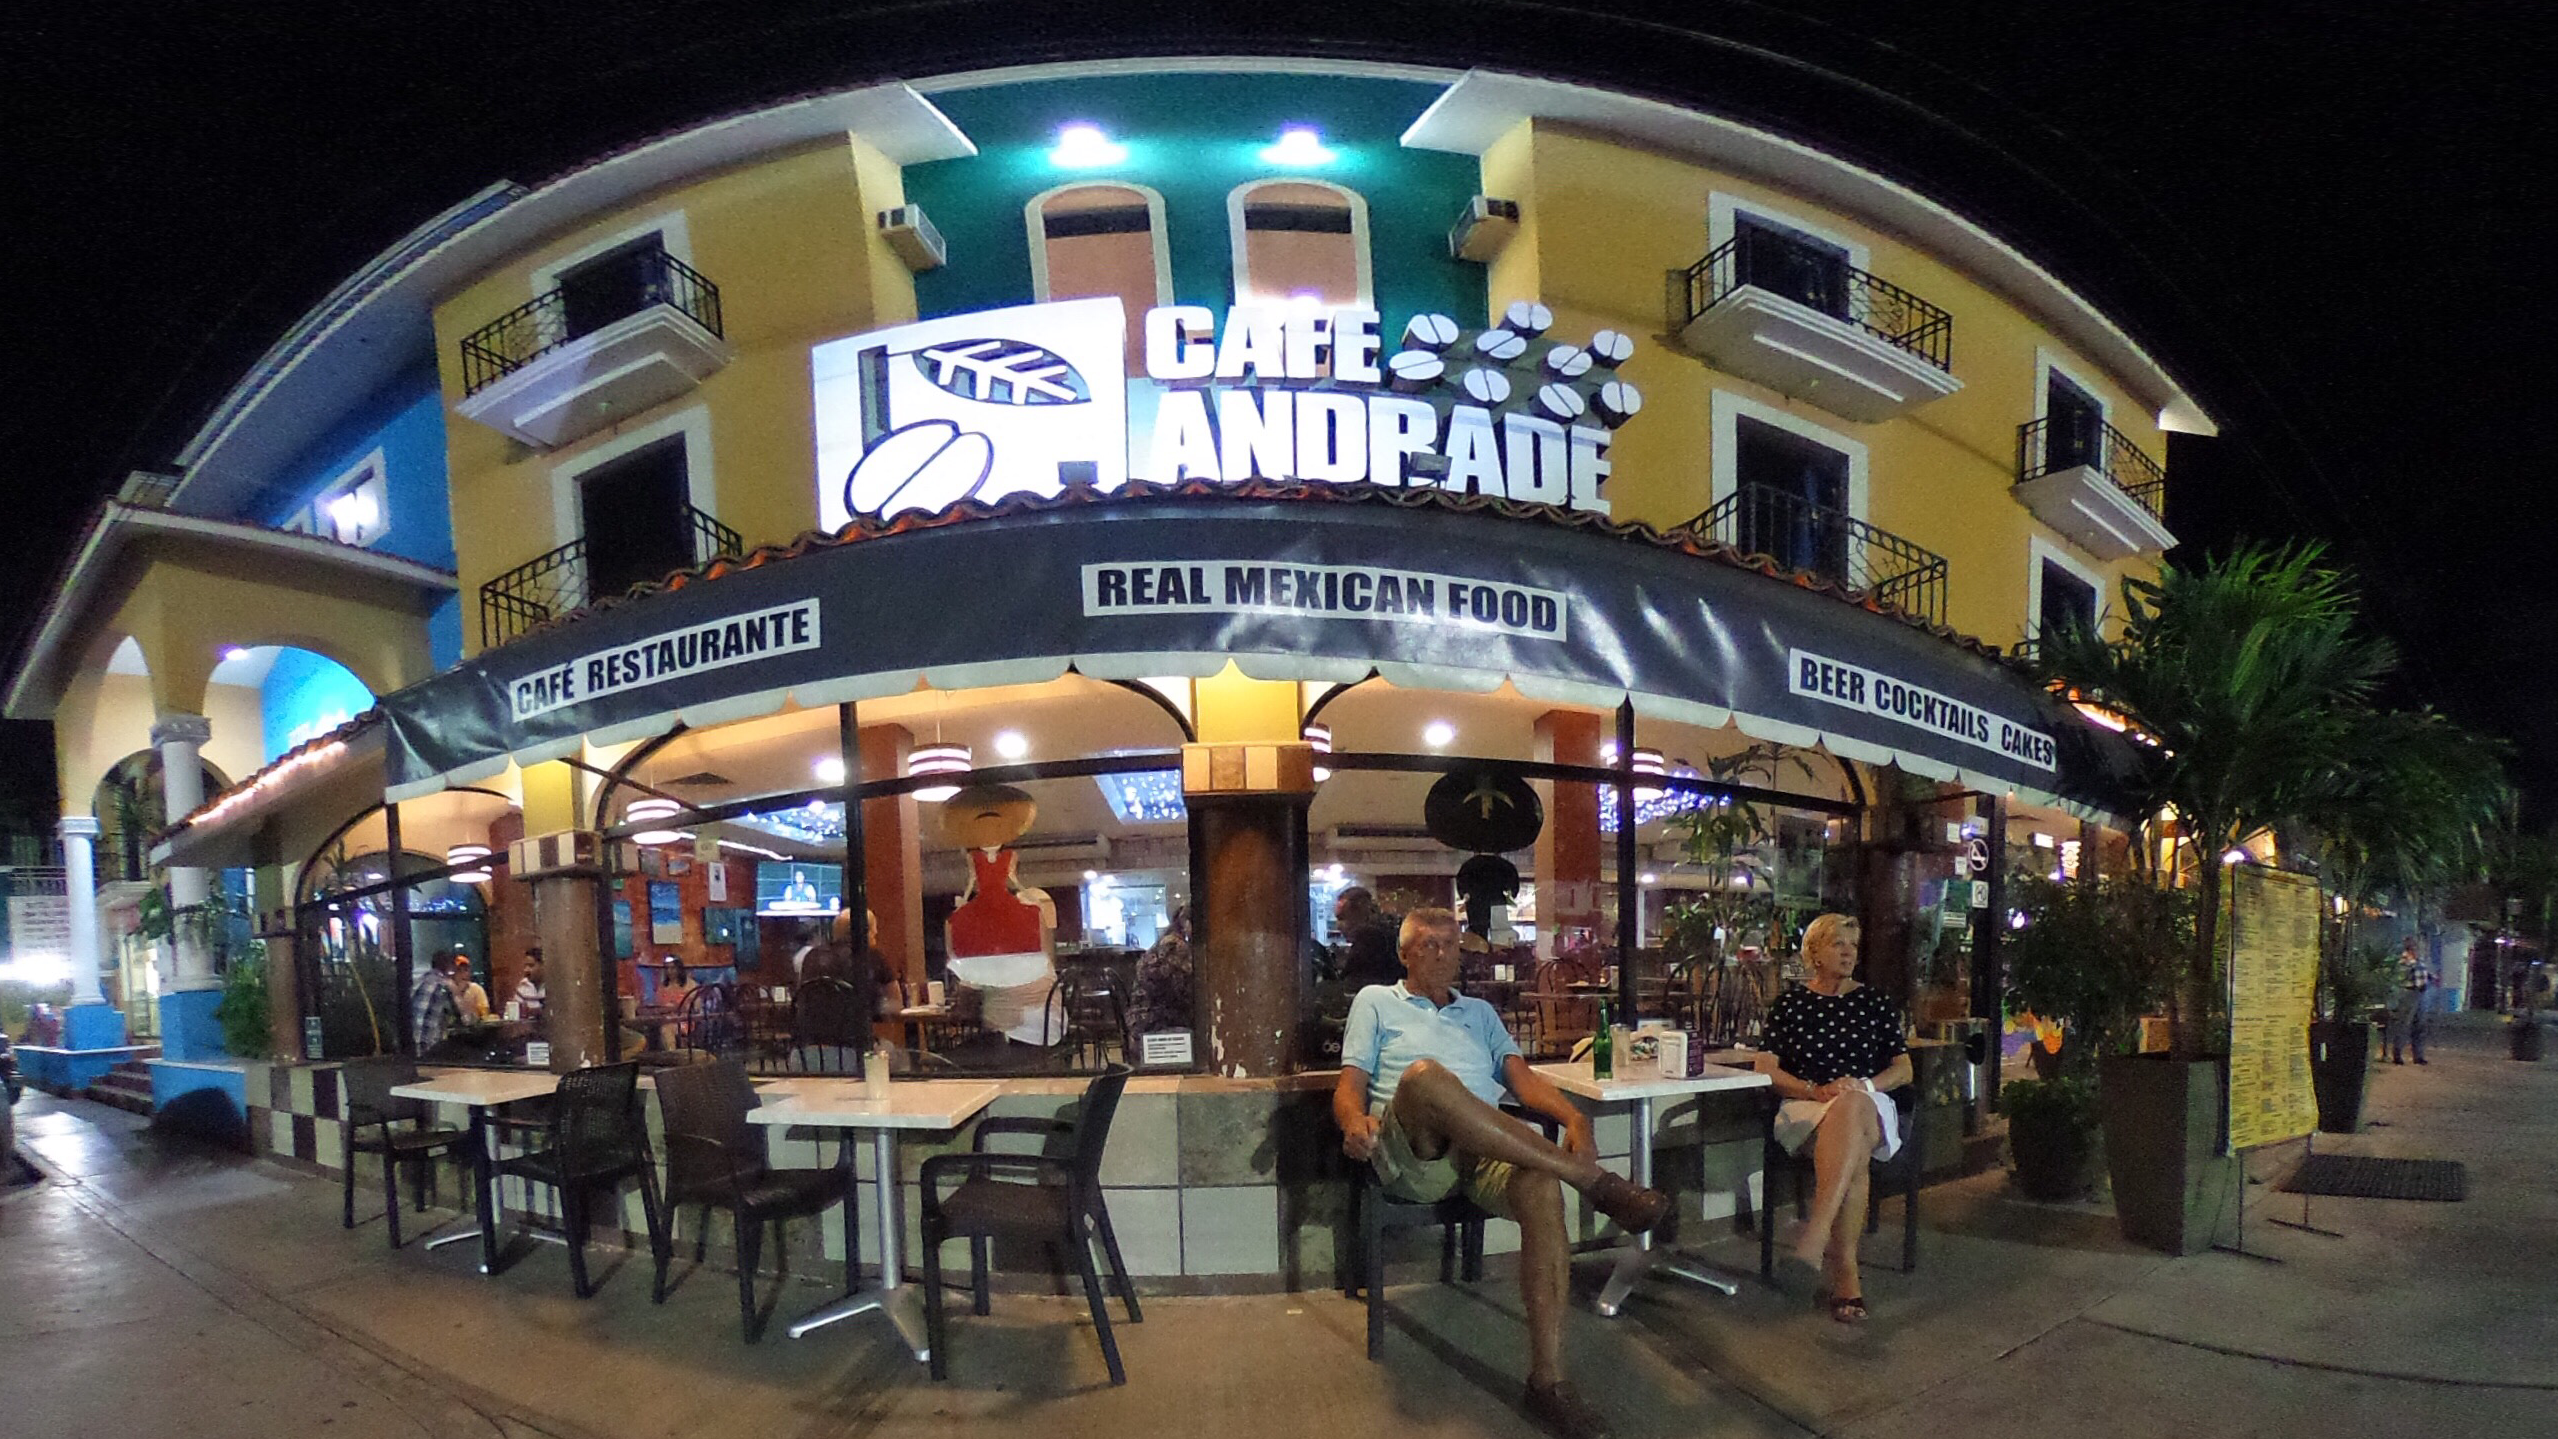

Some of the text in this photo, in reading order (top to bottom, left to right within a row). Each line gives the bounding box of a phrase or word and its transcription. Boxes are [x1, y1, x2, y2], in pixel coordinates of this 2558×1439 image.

[1145, 305, 1381, 383] CAFE
[1150, 390, 1611, 514] ANDRADE
[1098, 567, 1558, 632] REAL MEXICAN FOOD
[517, 607, 810, 714] CAFÉ RESTAURANTE
[1800, 657, 2054, 766] BEER COCKTAILS CAKES
